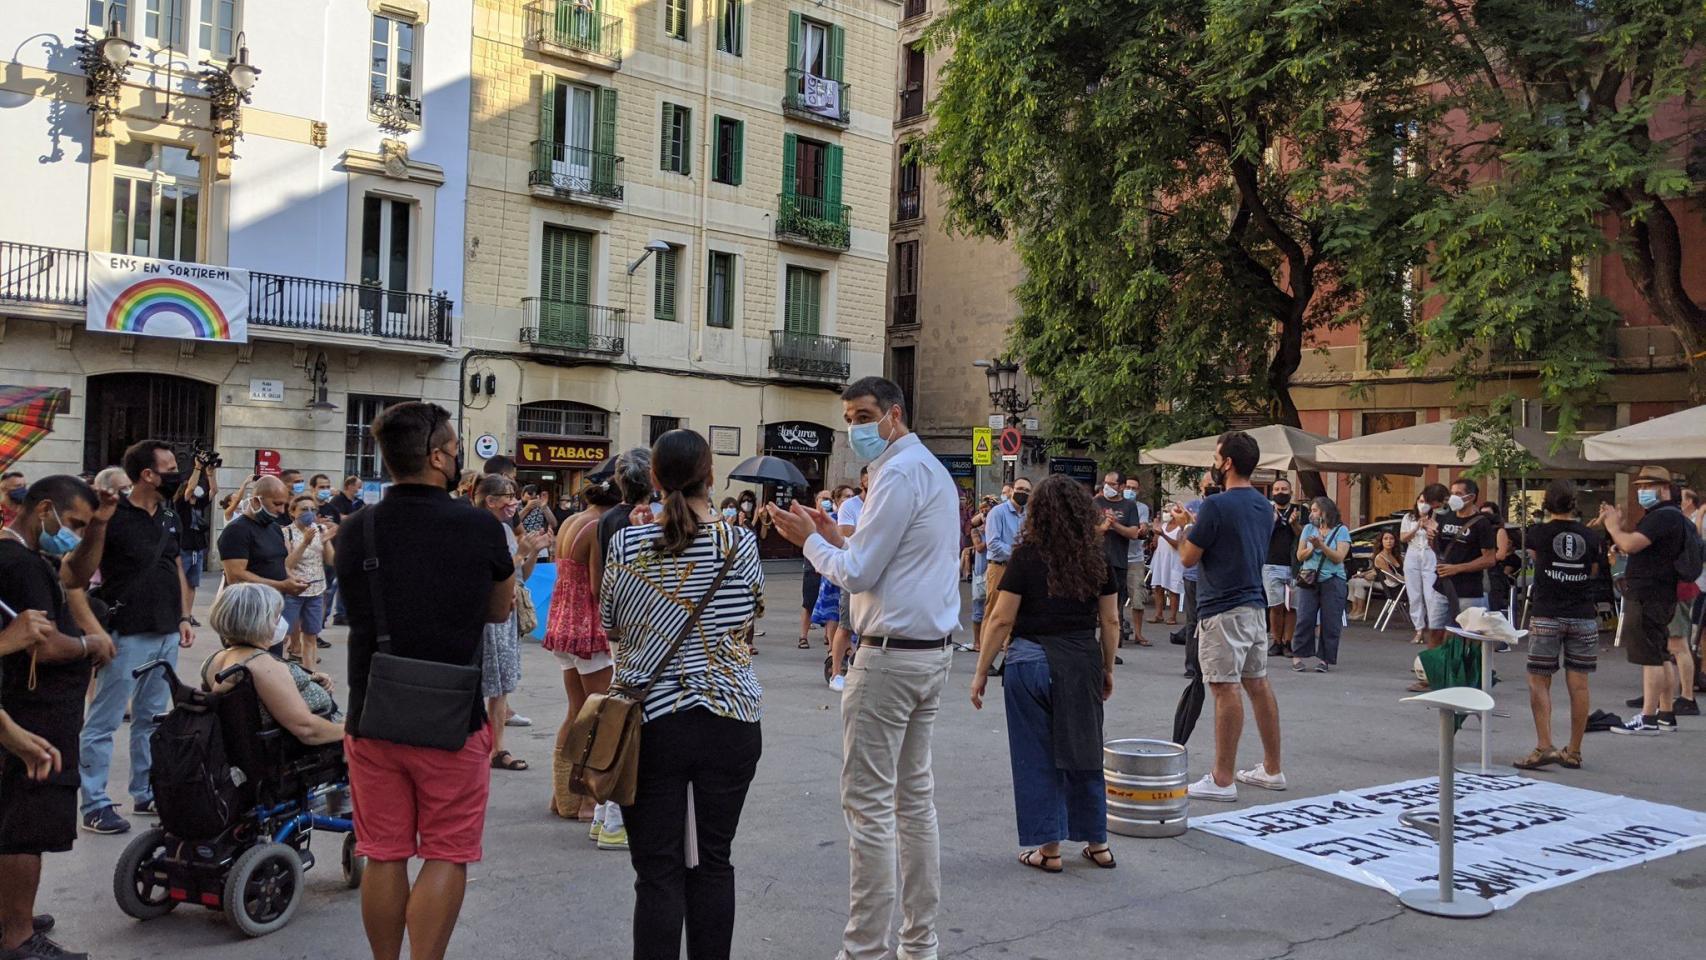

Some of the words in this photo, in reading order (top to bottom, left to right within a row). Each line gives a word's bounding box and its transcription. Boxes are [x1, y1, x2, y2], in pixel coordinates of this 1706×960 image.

[110, 257, 137, 272] ENS
[143, 262, 161, 273] EN
[548, 446, 604, 460] TABACS
